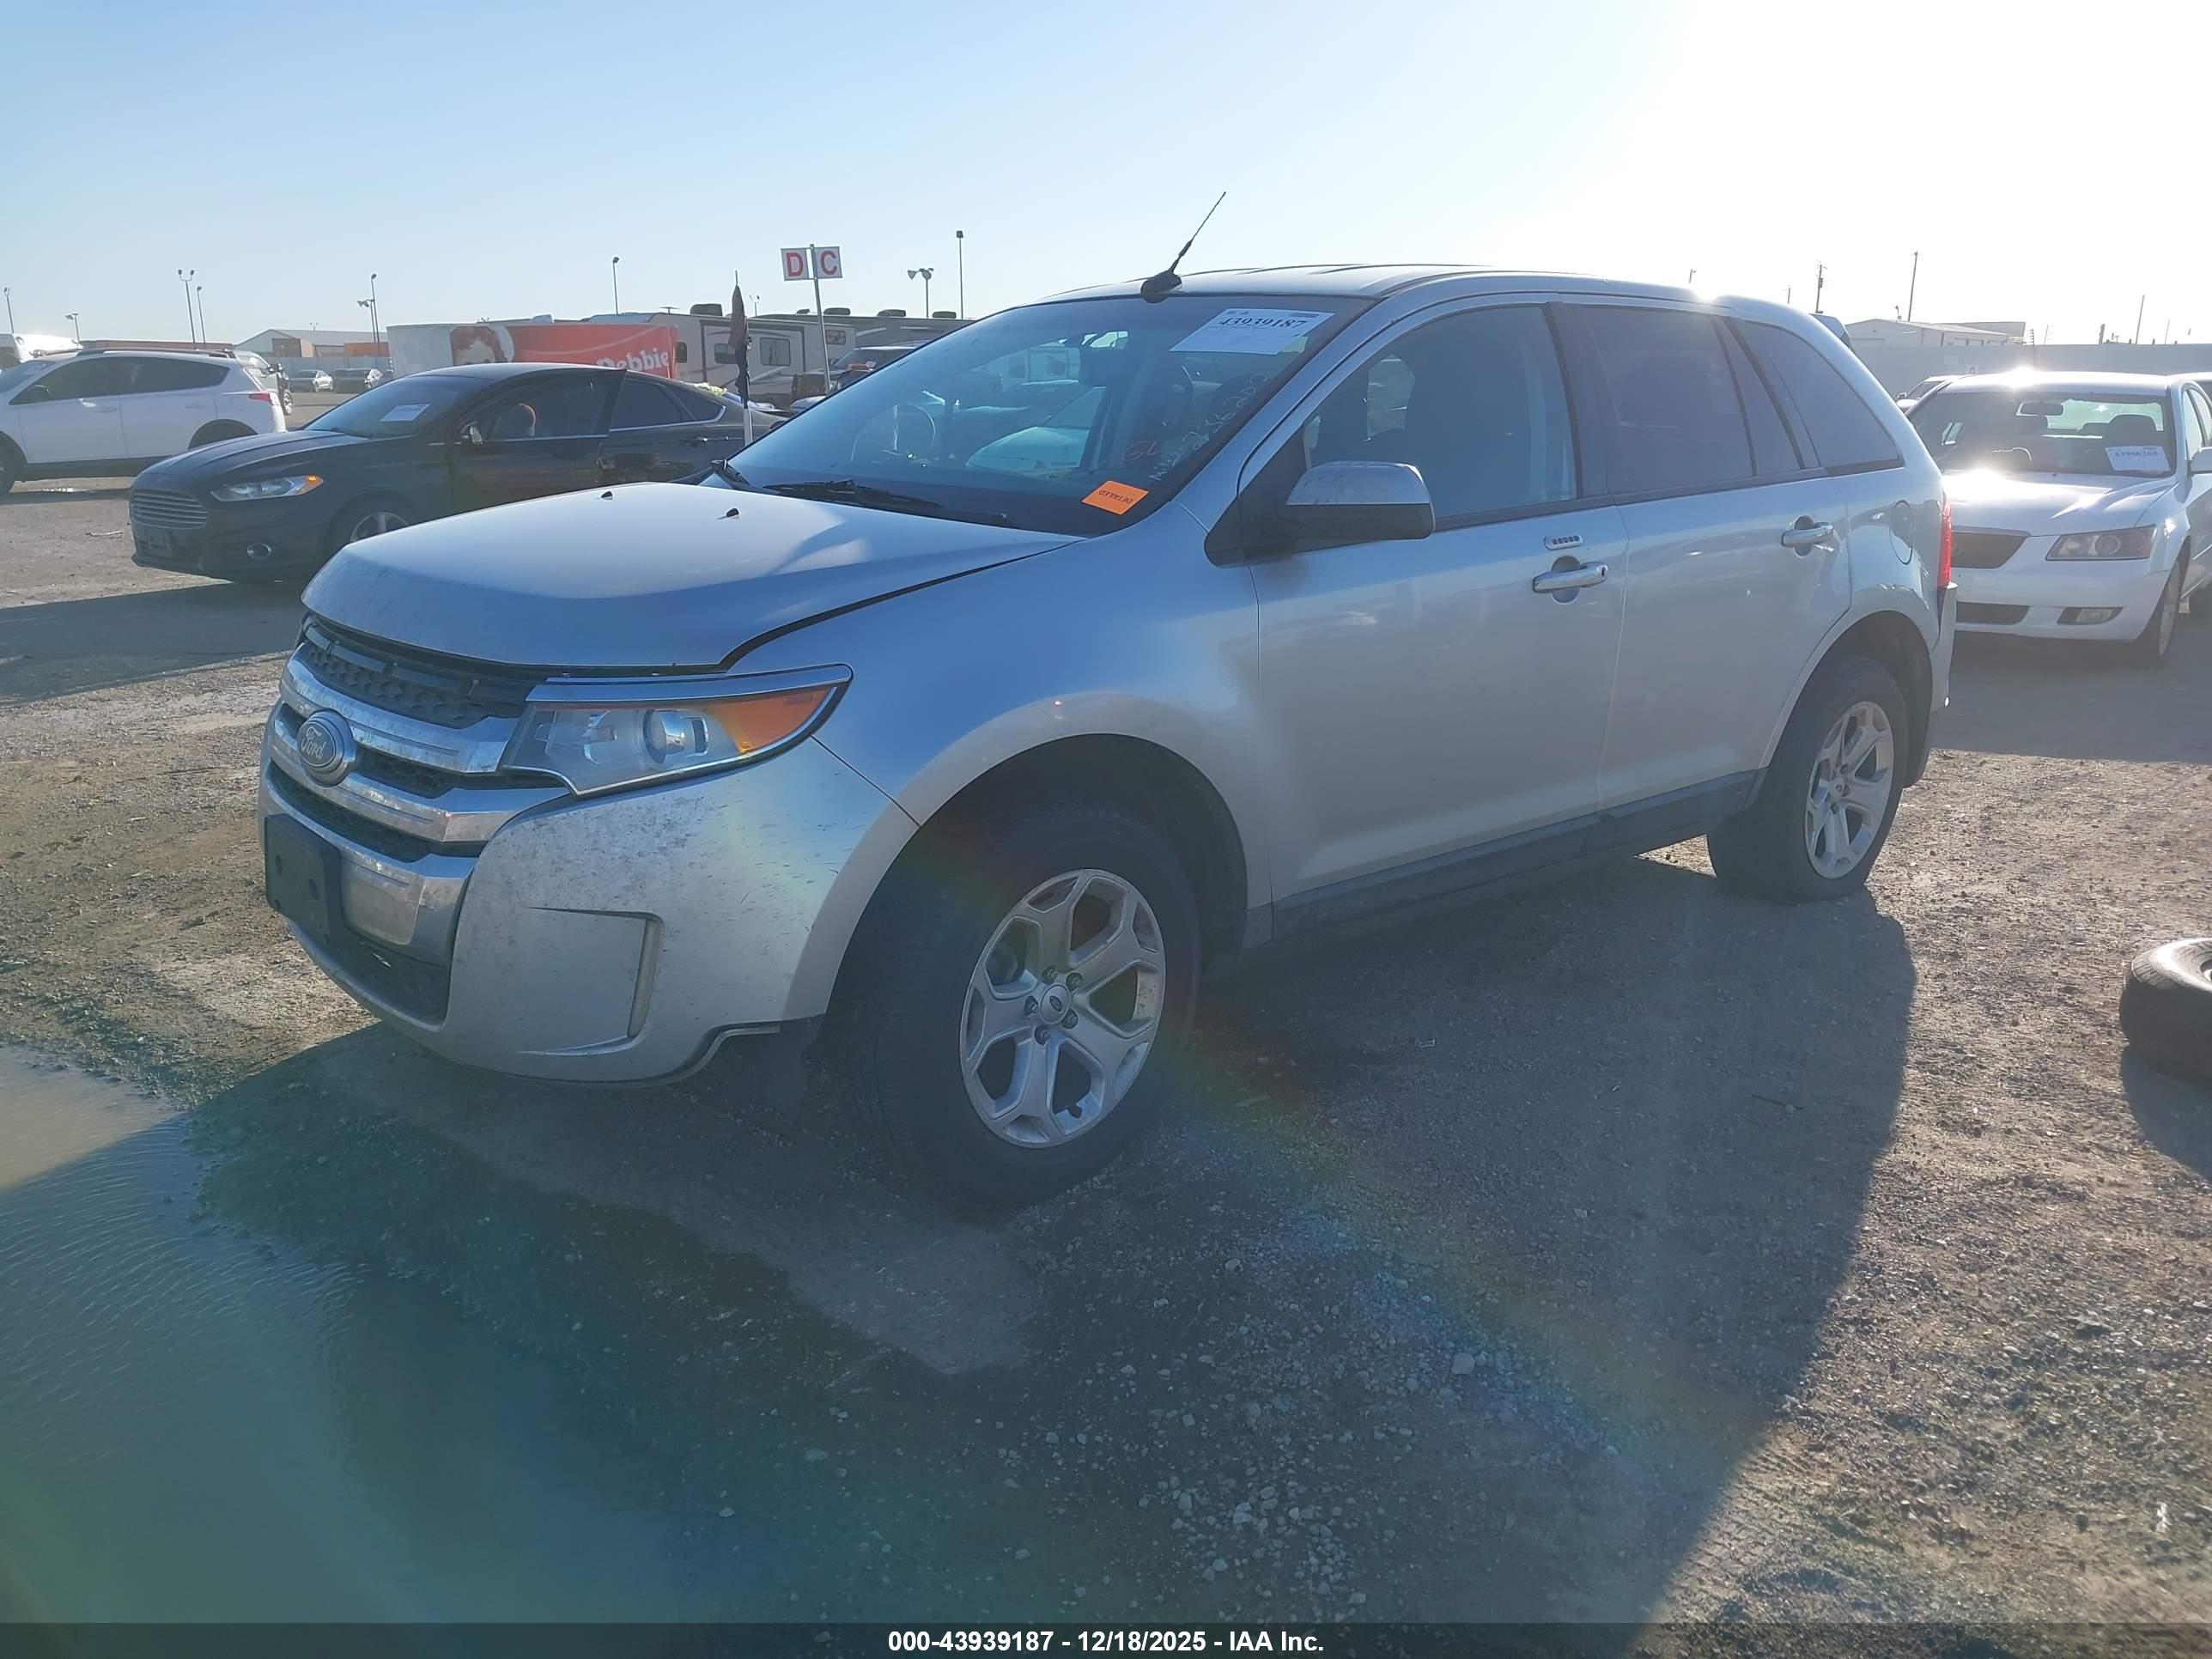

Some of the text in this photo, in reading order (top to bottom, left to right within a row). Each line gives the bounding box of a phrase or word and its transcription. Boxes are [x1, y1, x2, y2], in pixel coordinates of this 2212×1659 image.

[786, 252, 804, 276] D
[820, 250, 838, 276] C
[1219, 317, 1308, 328] 43939187
[1098, 489, 1133, 504] DETAILED
[301, 726, 327, 760] Ford
